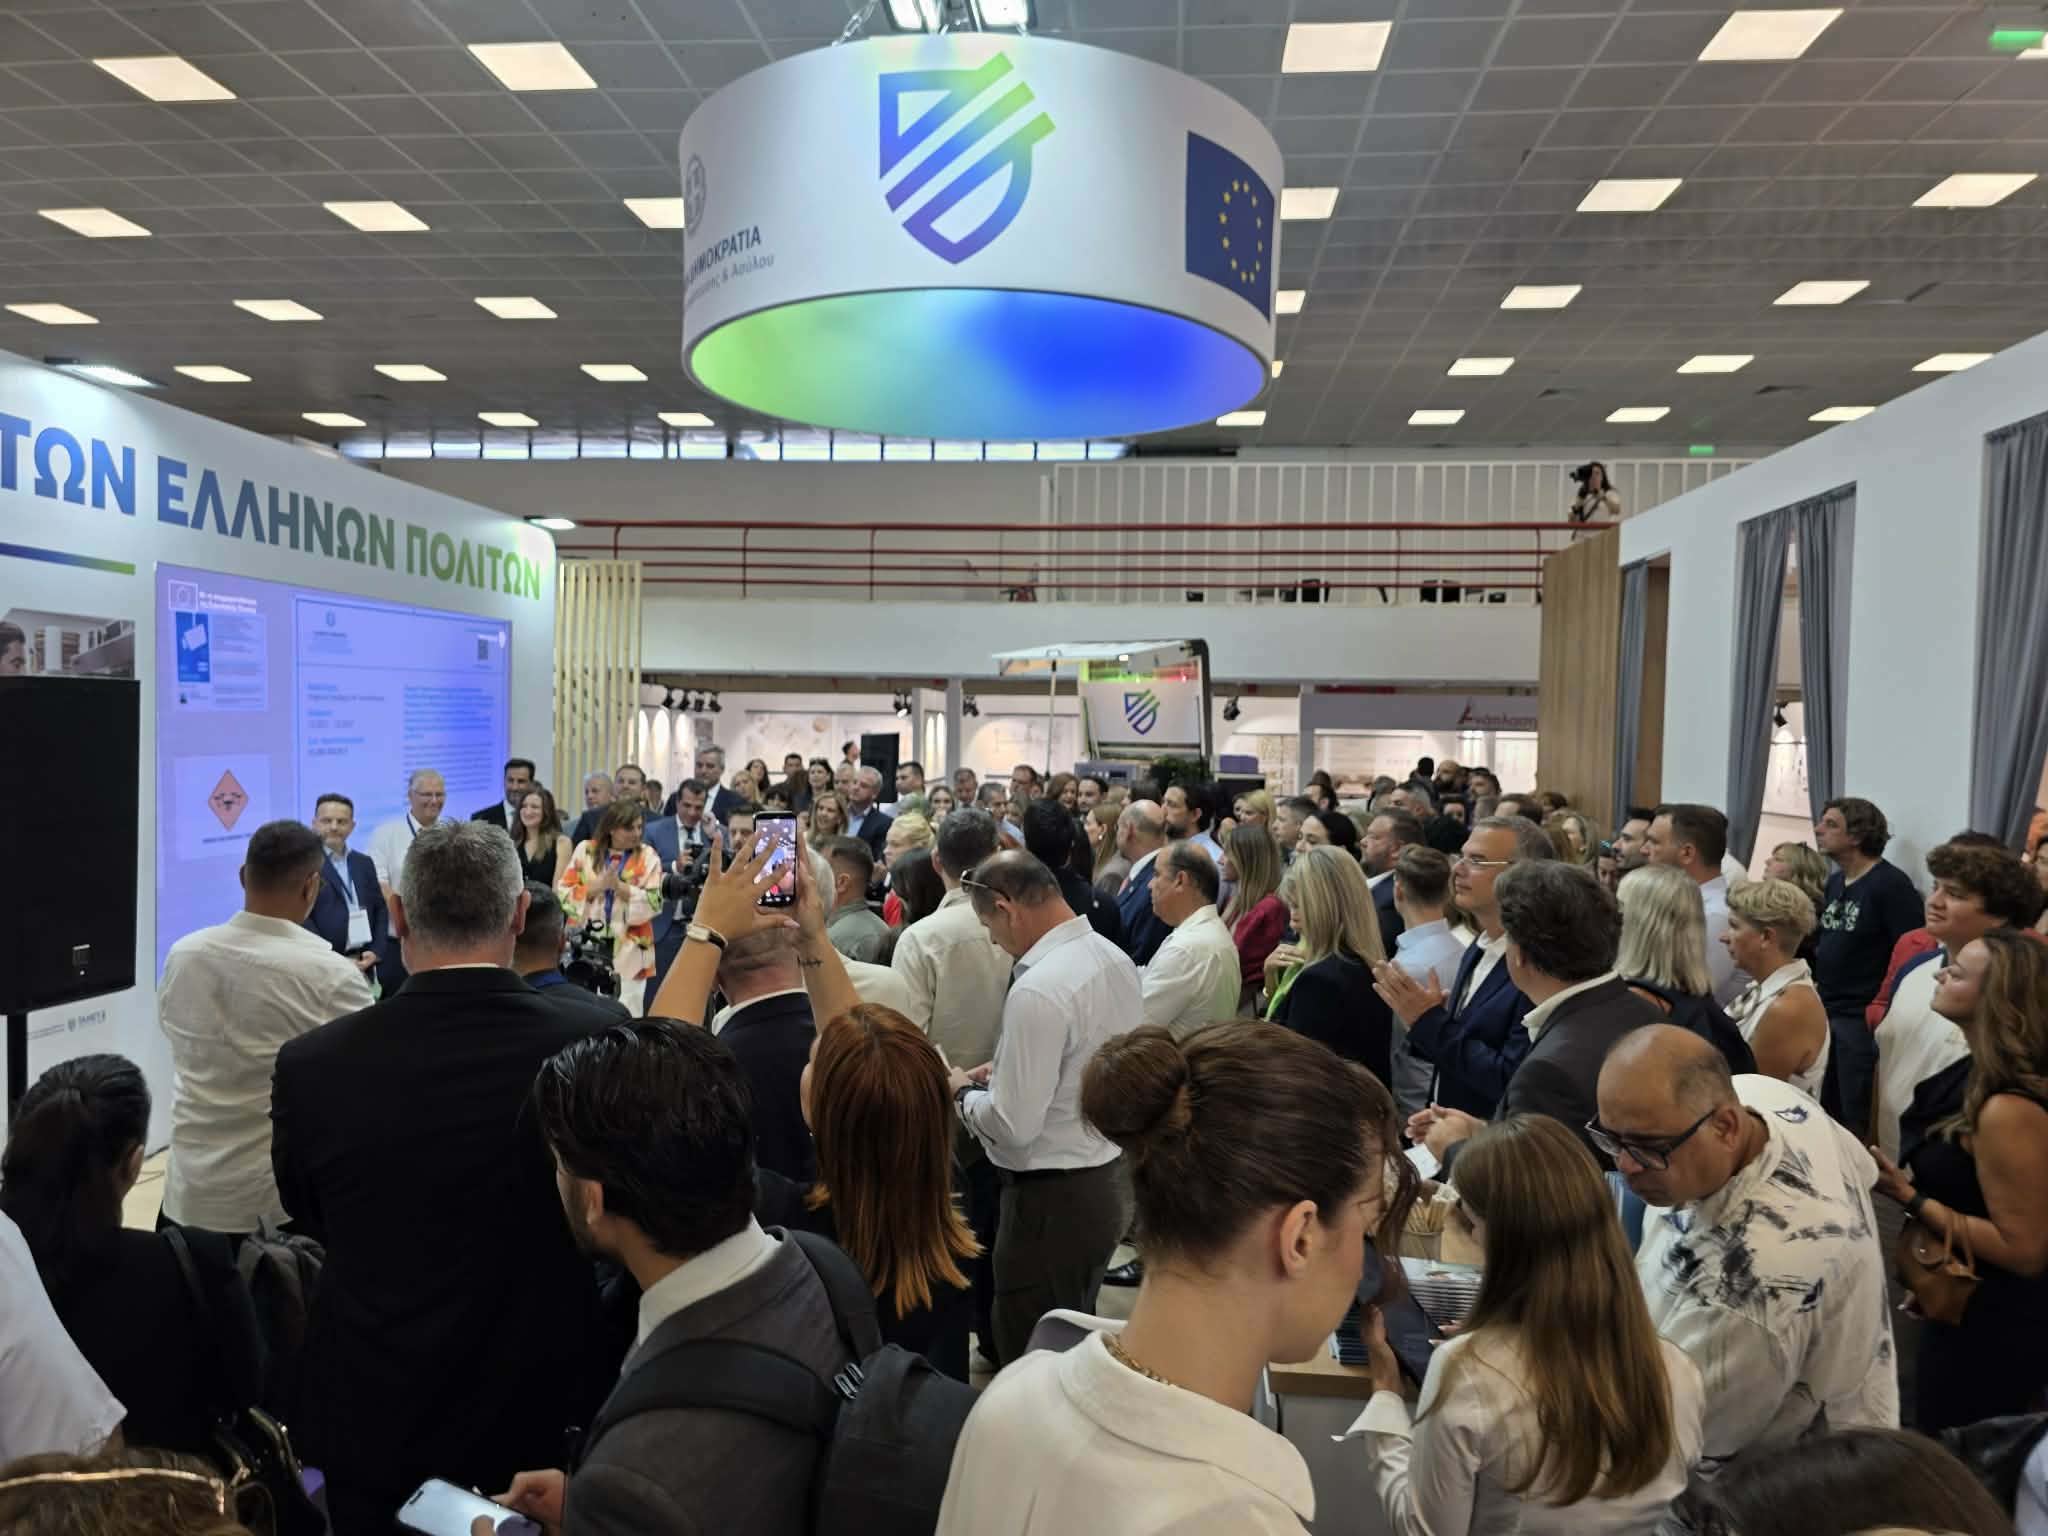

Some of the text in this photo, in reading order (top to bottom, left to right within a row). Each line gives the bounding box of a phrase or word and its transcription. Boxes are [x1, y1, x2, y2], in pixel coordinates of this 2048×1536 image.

[0, 412, 541, 601] ΤΩΝ ΕΛΛΗΝΩΝ ΠΟΛΙΤΩΝ
